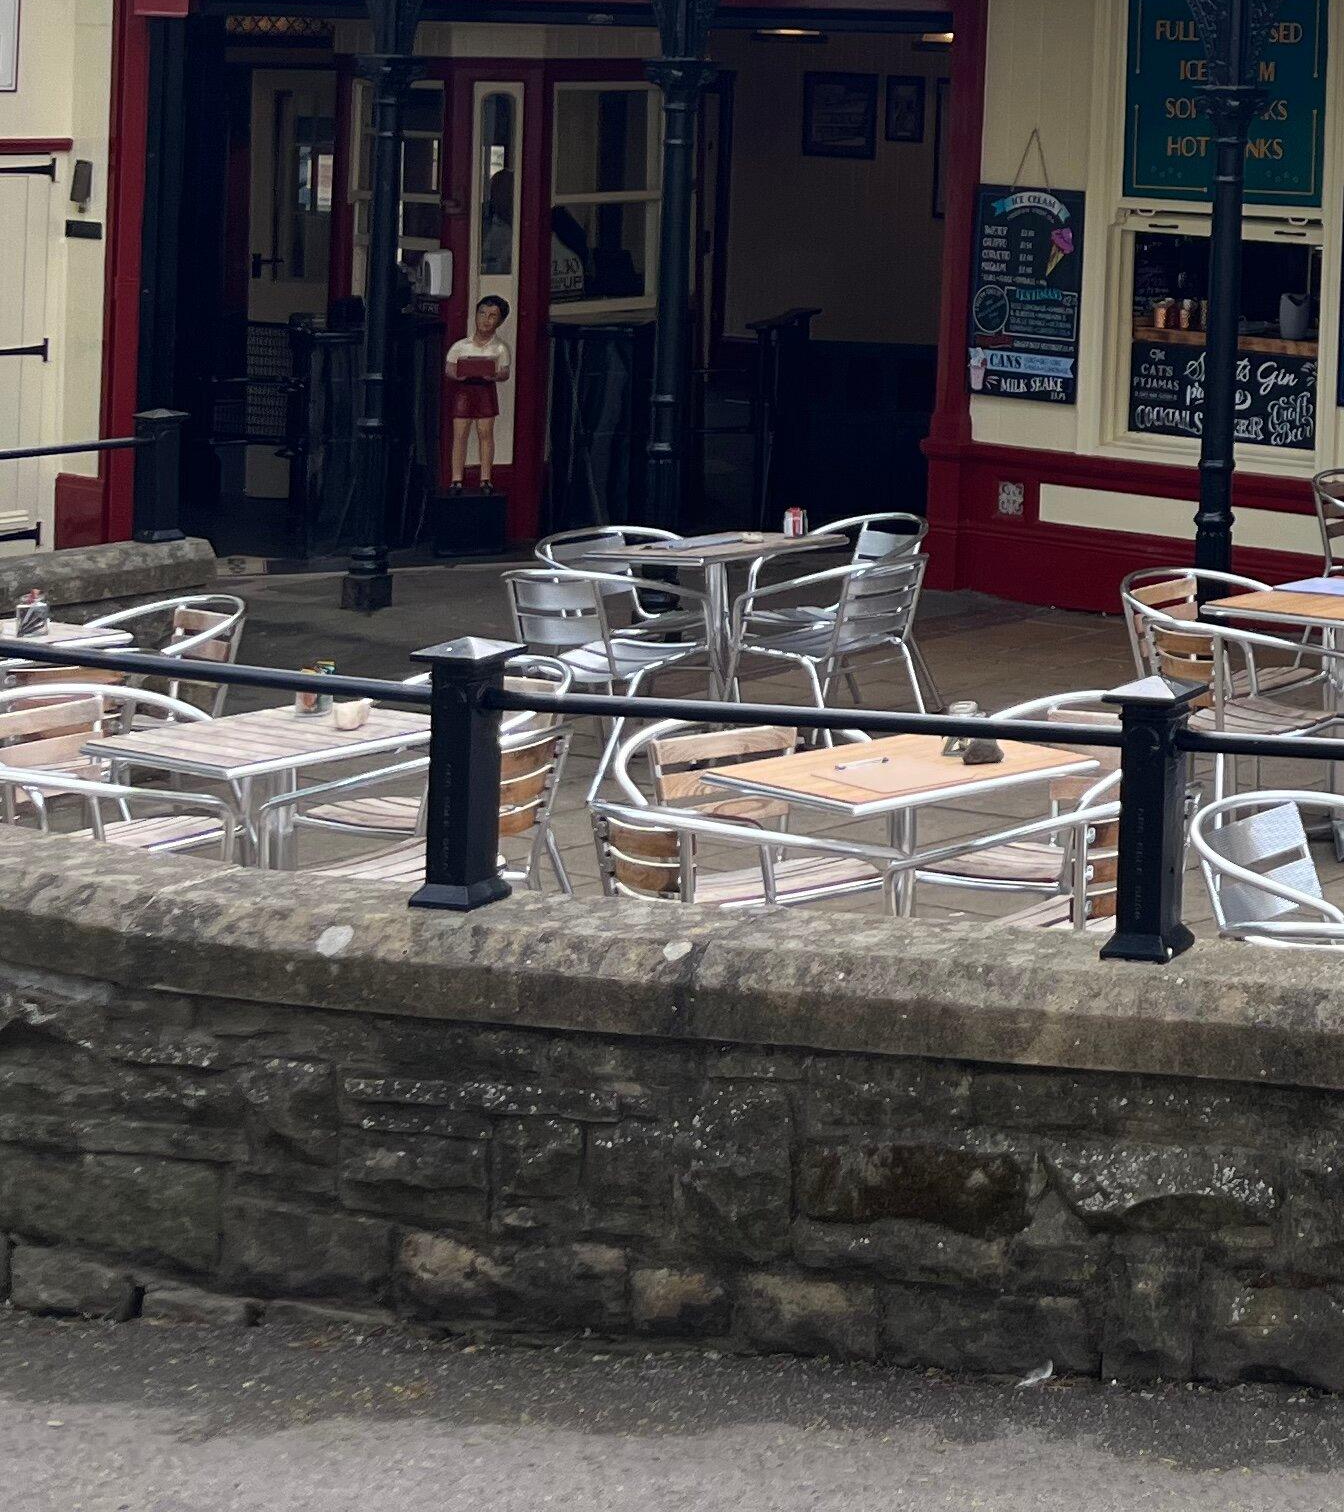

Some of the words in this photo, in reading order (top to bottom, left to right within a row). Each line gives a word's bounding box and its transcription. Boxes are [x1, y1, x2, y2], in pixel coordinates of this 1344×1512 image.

[1156, 19, 1199, 41] FULL
[1180, 60, 1208, 80] ICE
[1167, 136, 1210, 157] HOT
[990, 353, 1022, 369] CANS
[1000, 377, 1028, 393] MILK
[1133, 376, 1180, 391] PYJAMAS
[1256, 361, 1298, 396] Gin
